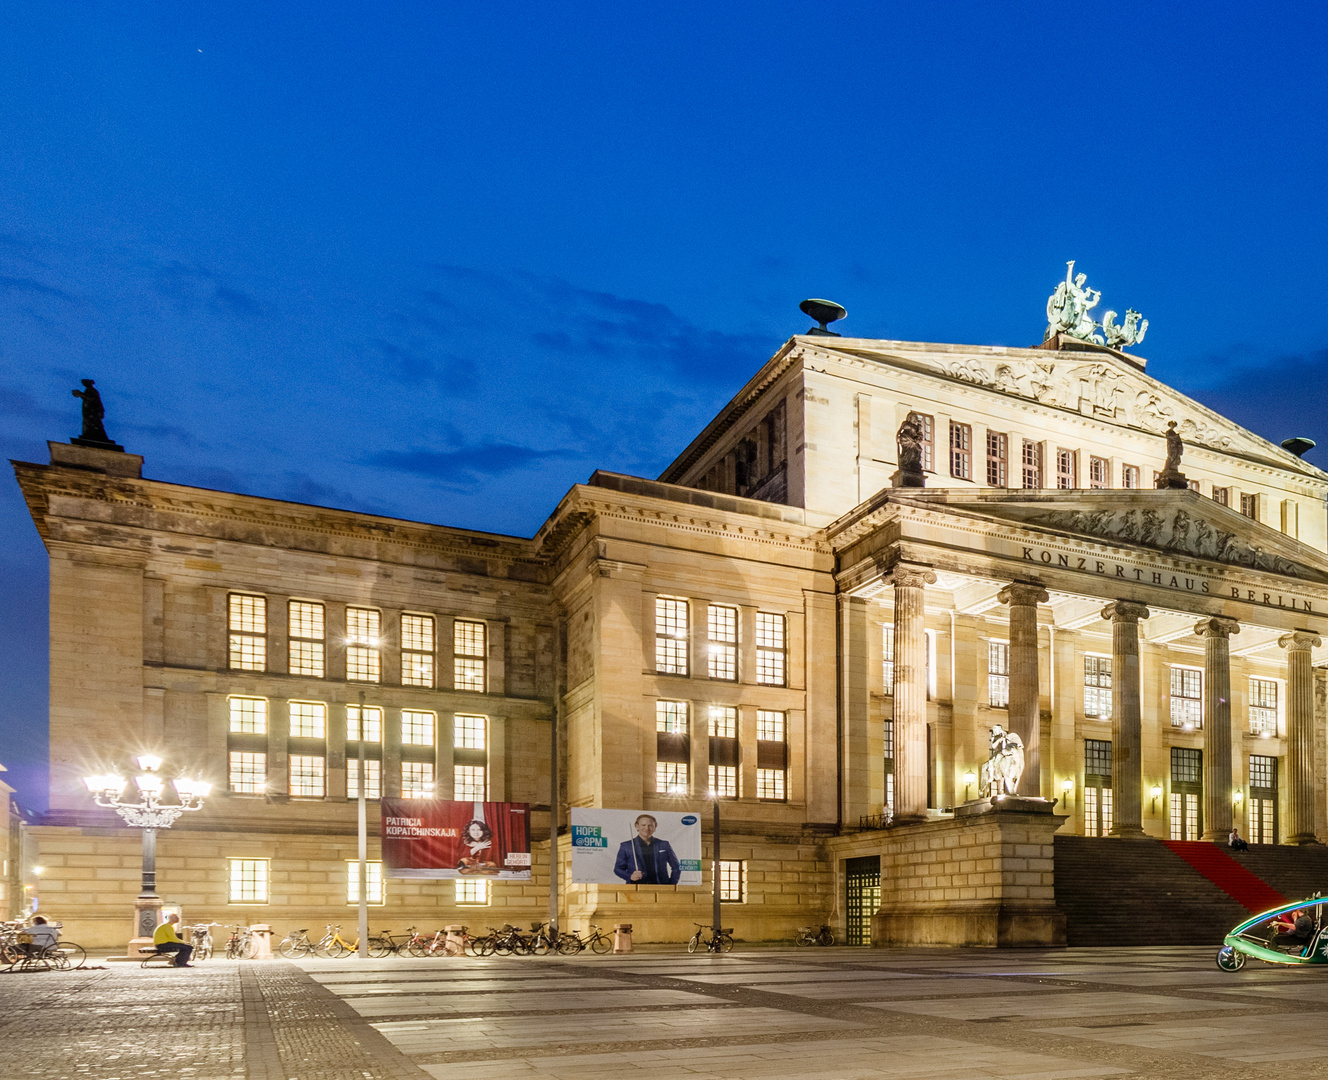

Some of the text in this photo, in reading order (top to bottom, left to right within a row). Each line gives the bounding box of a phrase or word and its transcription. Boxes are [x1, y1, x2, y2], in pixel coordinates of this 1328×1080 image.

[1021, 546, 1313, 612] KONZERTHAUS BERLIN
[386, 817, 422, 827] PATRICIA
[386, 827, 456, 837] KOPATCHINSKAJA
[576, 826, 598, 836] HOPE
[576, 837, 602, 846] @9PM
